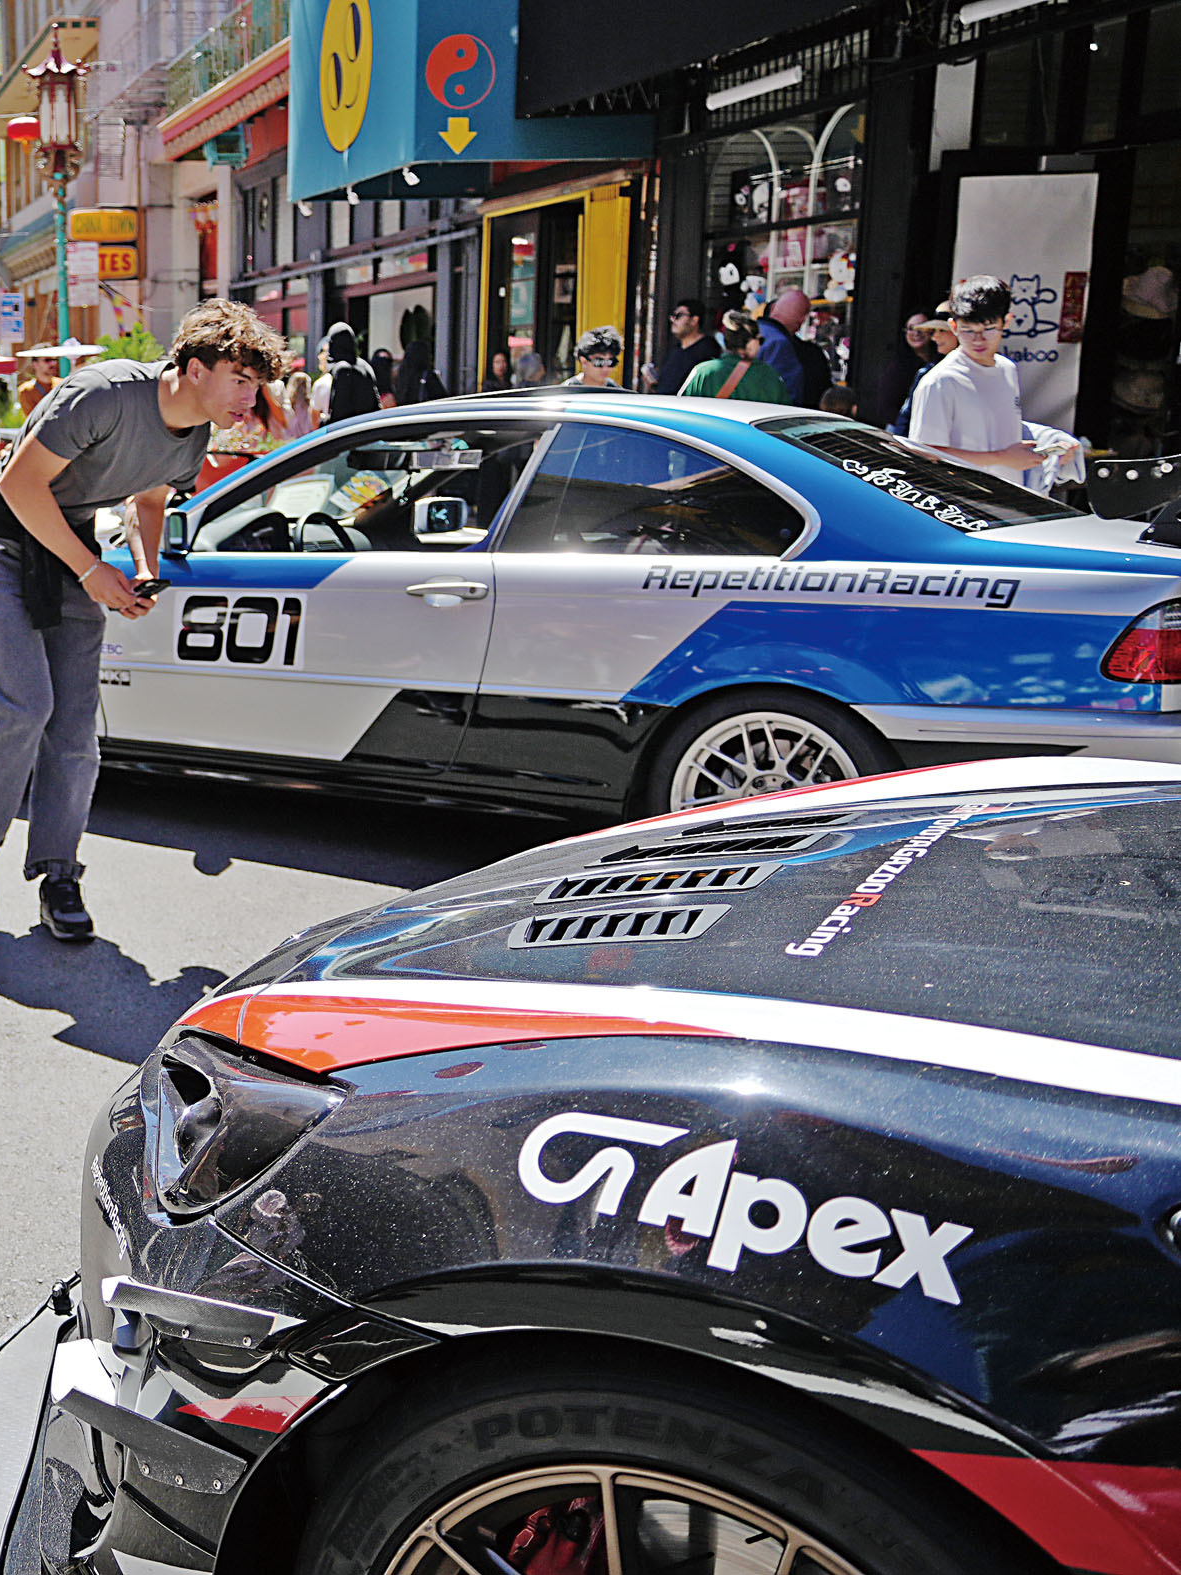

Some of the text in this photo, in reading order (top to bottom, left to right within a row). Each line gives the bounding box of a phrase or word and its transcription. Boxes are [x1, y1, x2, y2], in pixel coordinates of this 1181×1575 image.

[108, 215, 135, 233] TOWN
[642, 564, 1021, 609] RepetitionRacing
[177, 595, 302, 666] 801
[90, 1153, 128, 1261] RepetitionRacing
[637, 1138, 974, 1306] Apex
[472, 1404, 831, 1507] POTENZA
